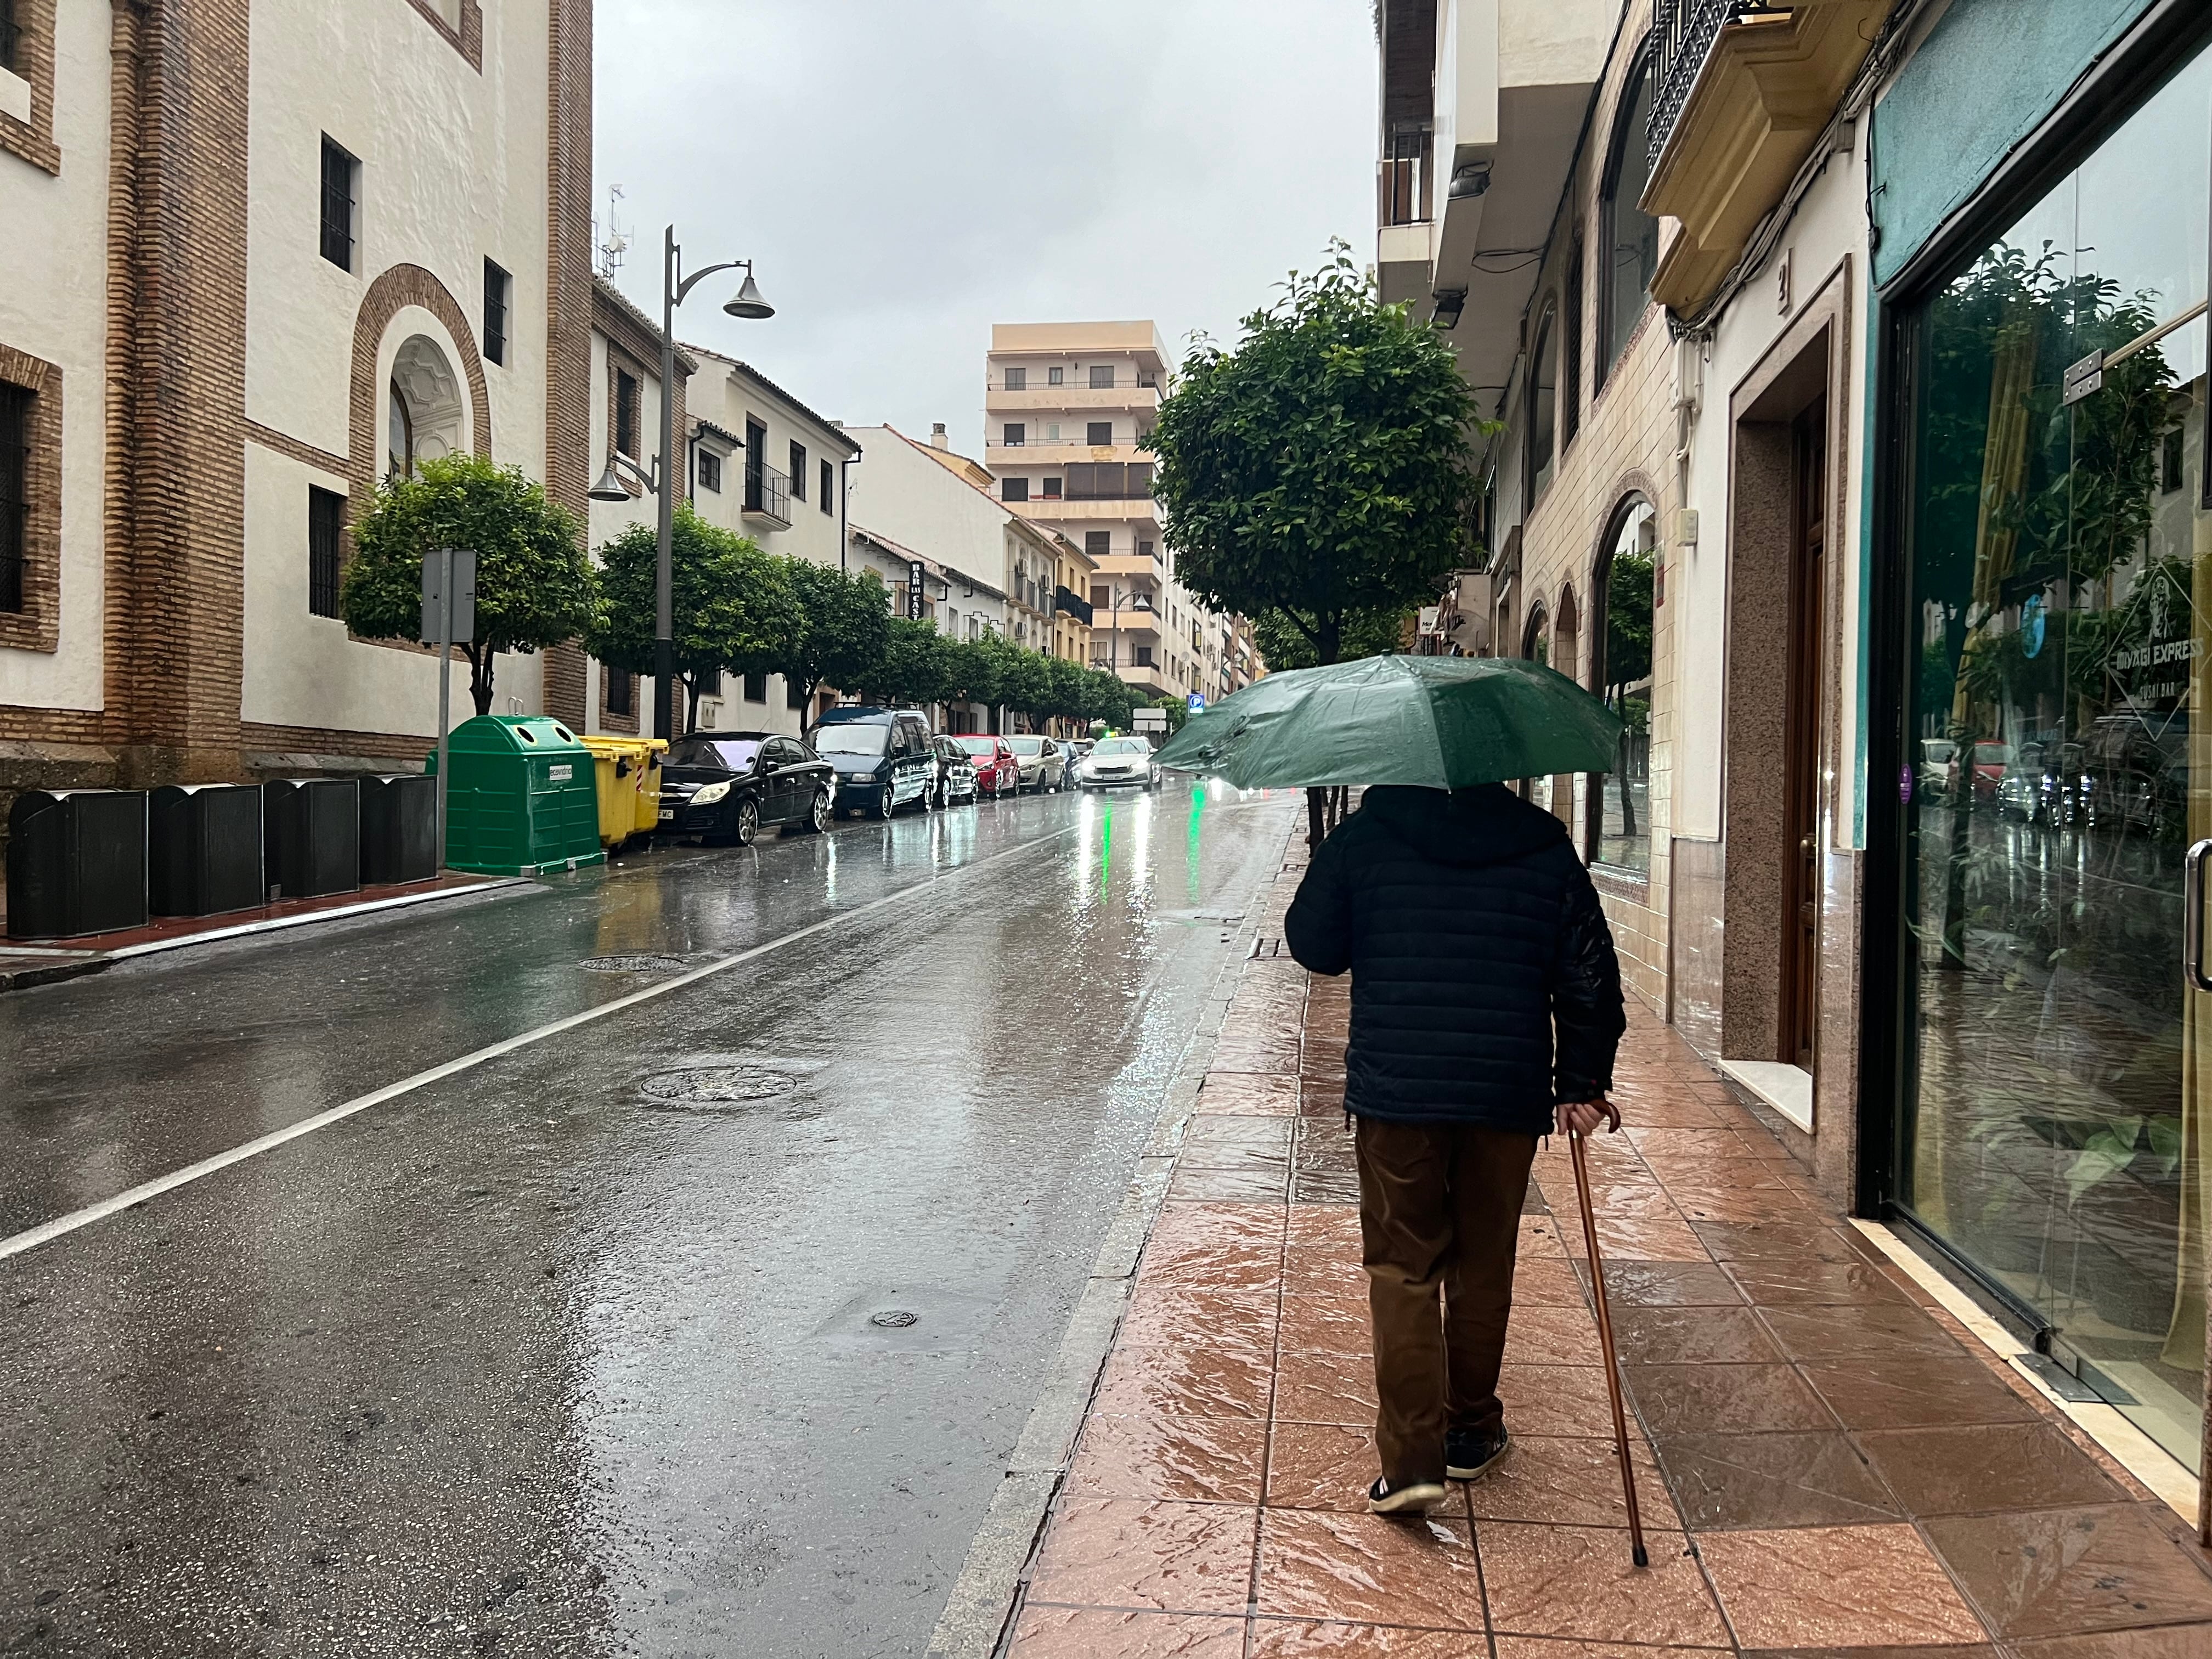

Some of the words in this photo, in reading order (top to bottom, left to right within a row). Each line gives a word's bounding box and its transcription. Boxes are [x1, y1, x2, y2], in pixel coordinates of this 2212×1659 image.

[2117, 647, 2150, 670] MIYAGI
[2153, 637, 2204, 665] EXPRESS
[2140, 683, 2159, 700] SUSHI
[2161, 682, 2175, 697] BAR
[1193, 697, 1201, 707] P
